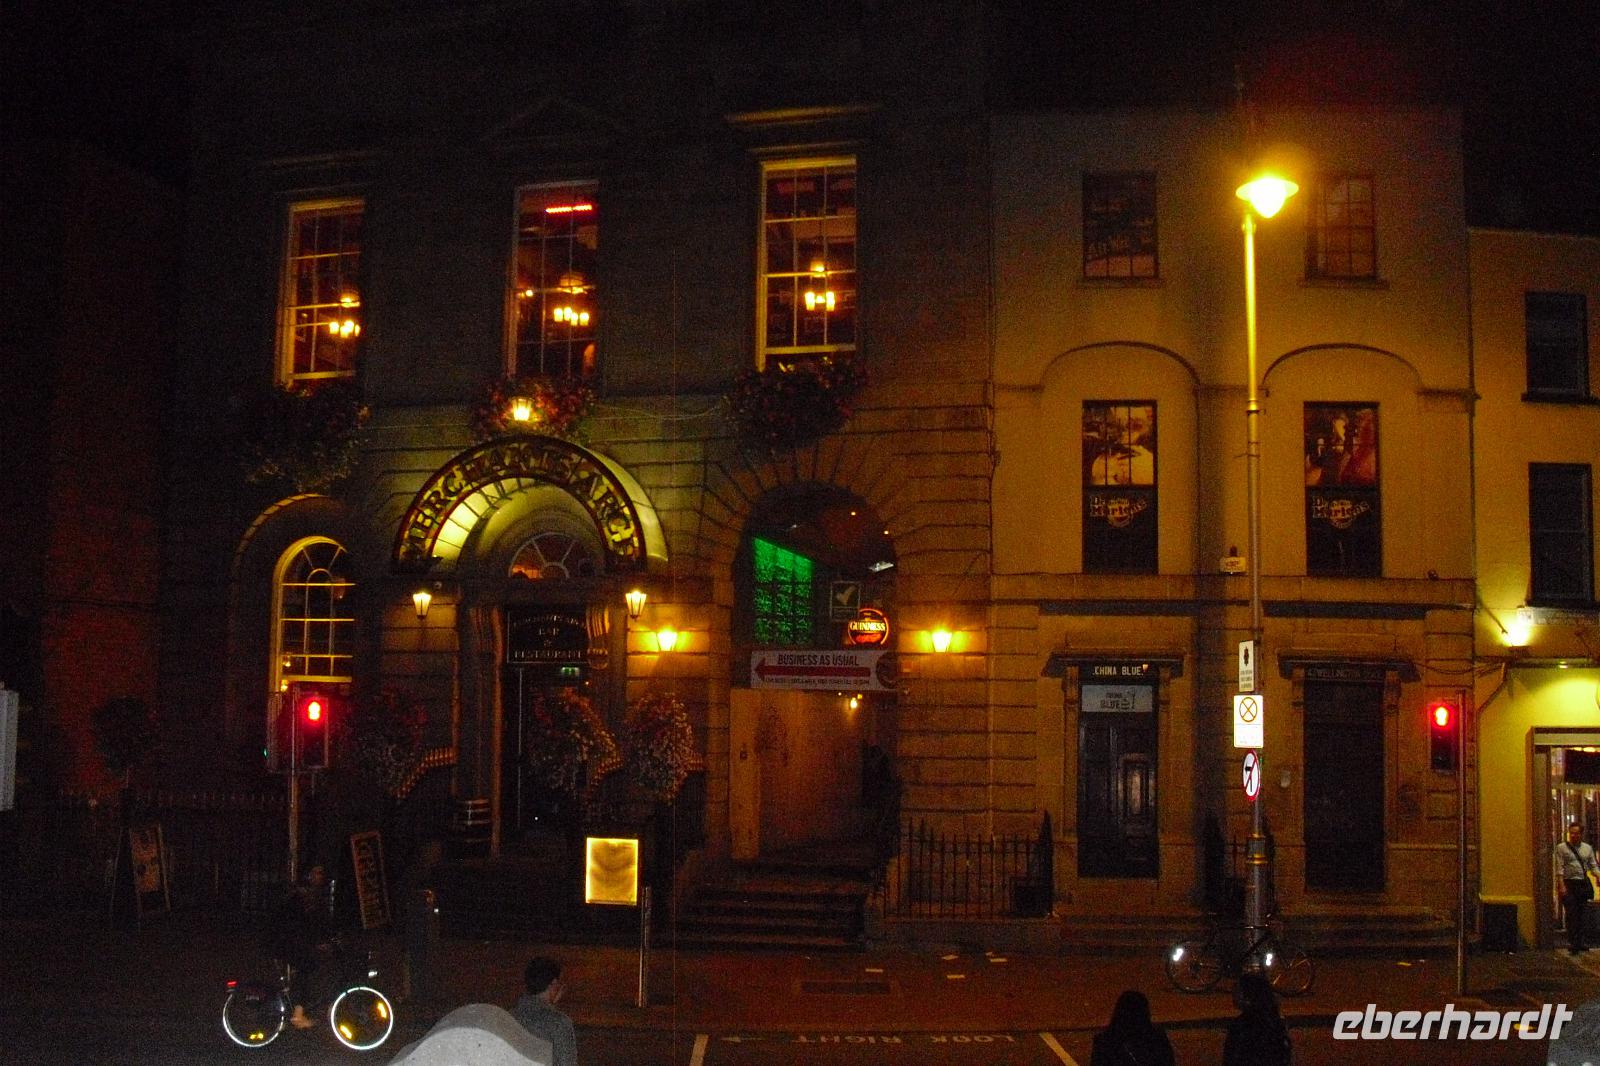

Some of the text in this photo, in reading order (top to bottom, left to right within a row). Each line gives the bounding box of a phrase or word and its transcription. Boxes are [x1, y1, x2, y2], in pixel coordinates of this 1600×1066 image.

[849, 621, 886, 632] GUINNESS
[778, 654, 859, 667] BUSINESS AS USUAL
[1094, 665, 1142, 676] CHINA BLUE
[791, 1034, 1016, 1044] LOOK RIGHT
